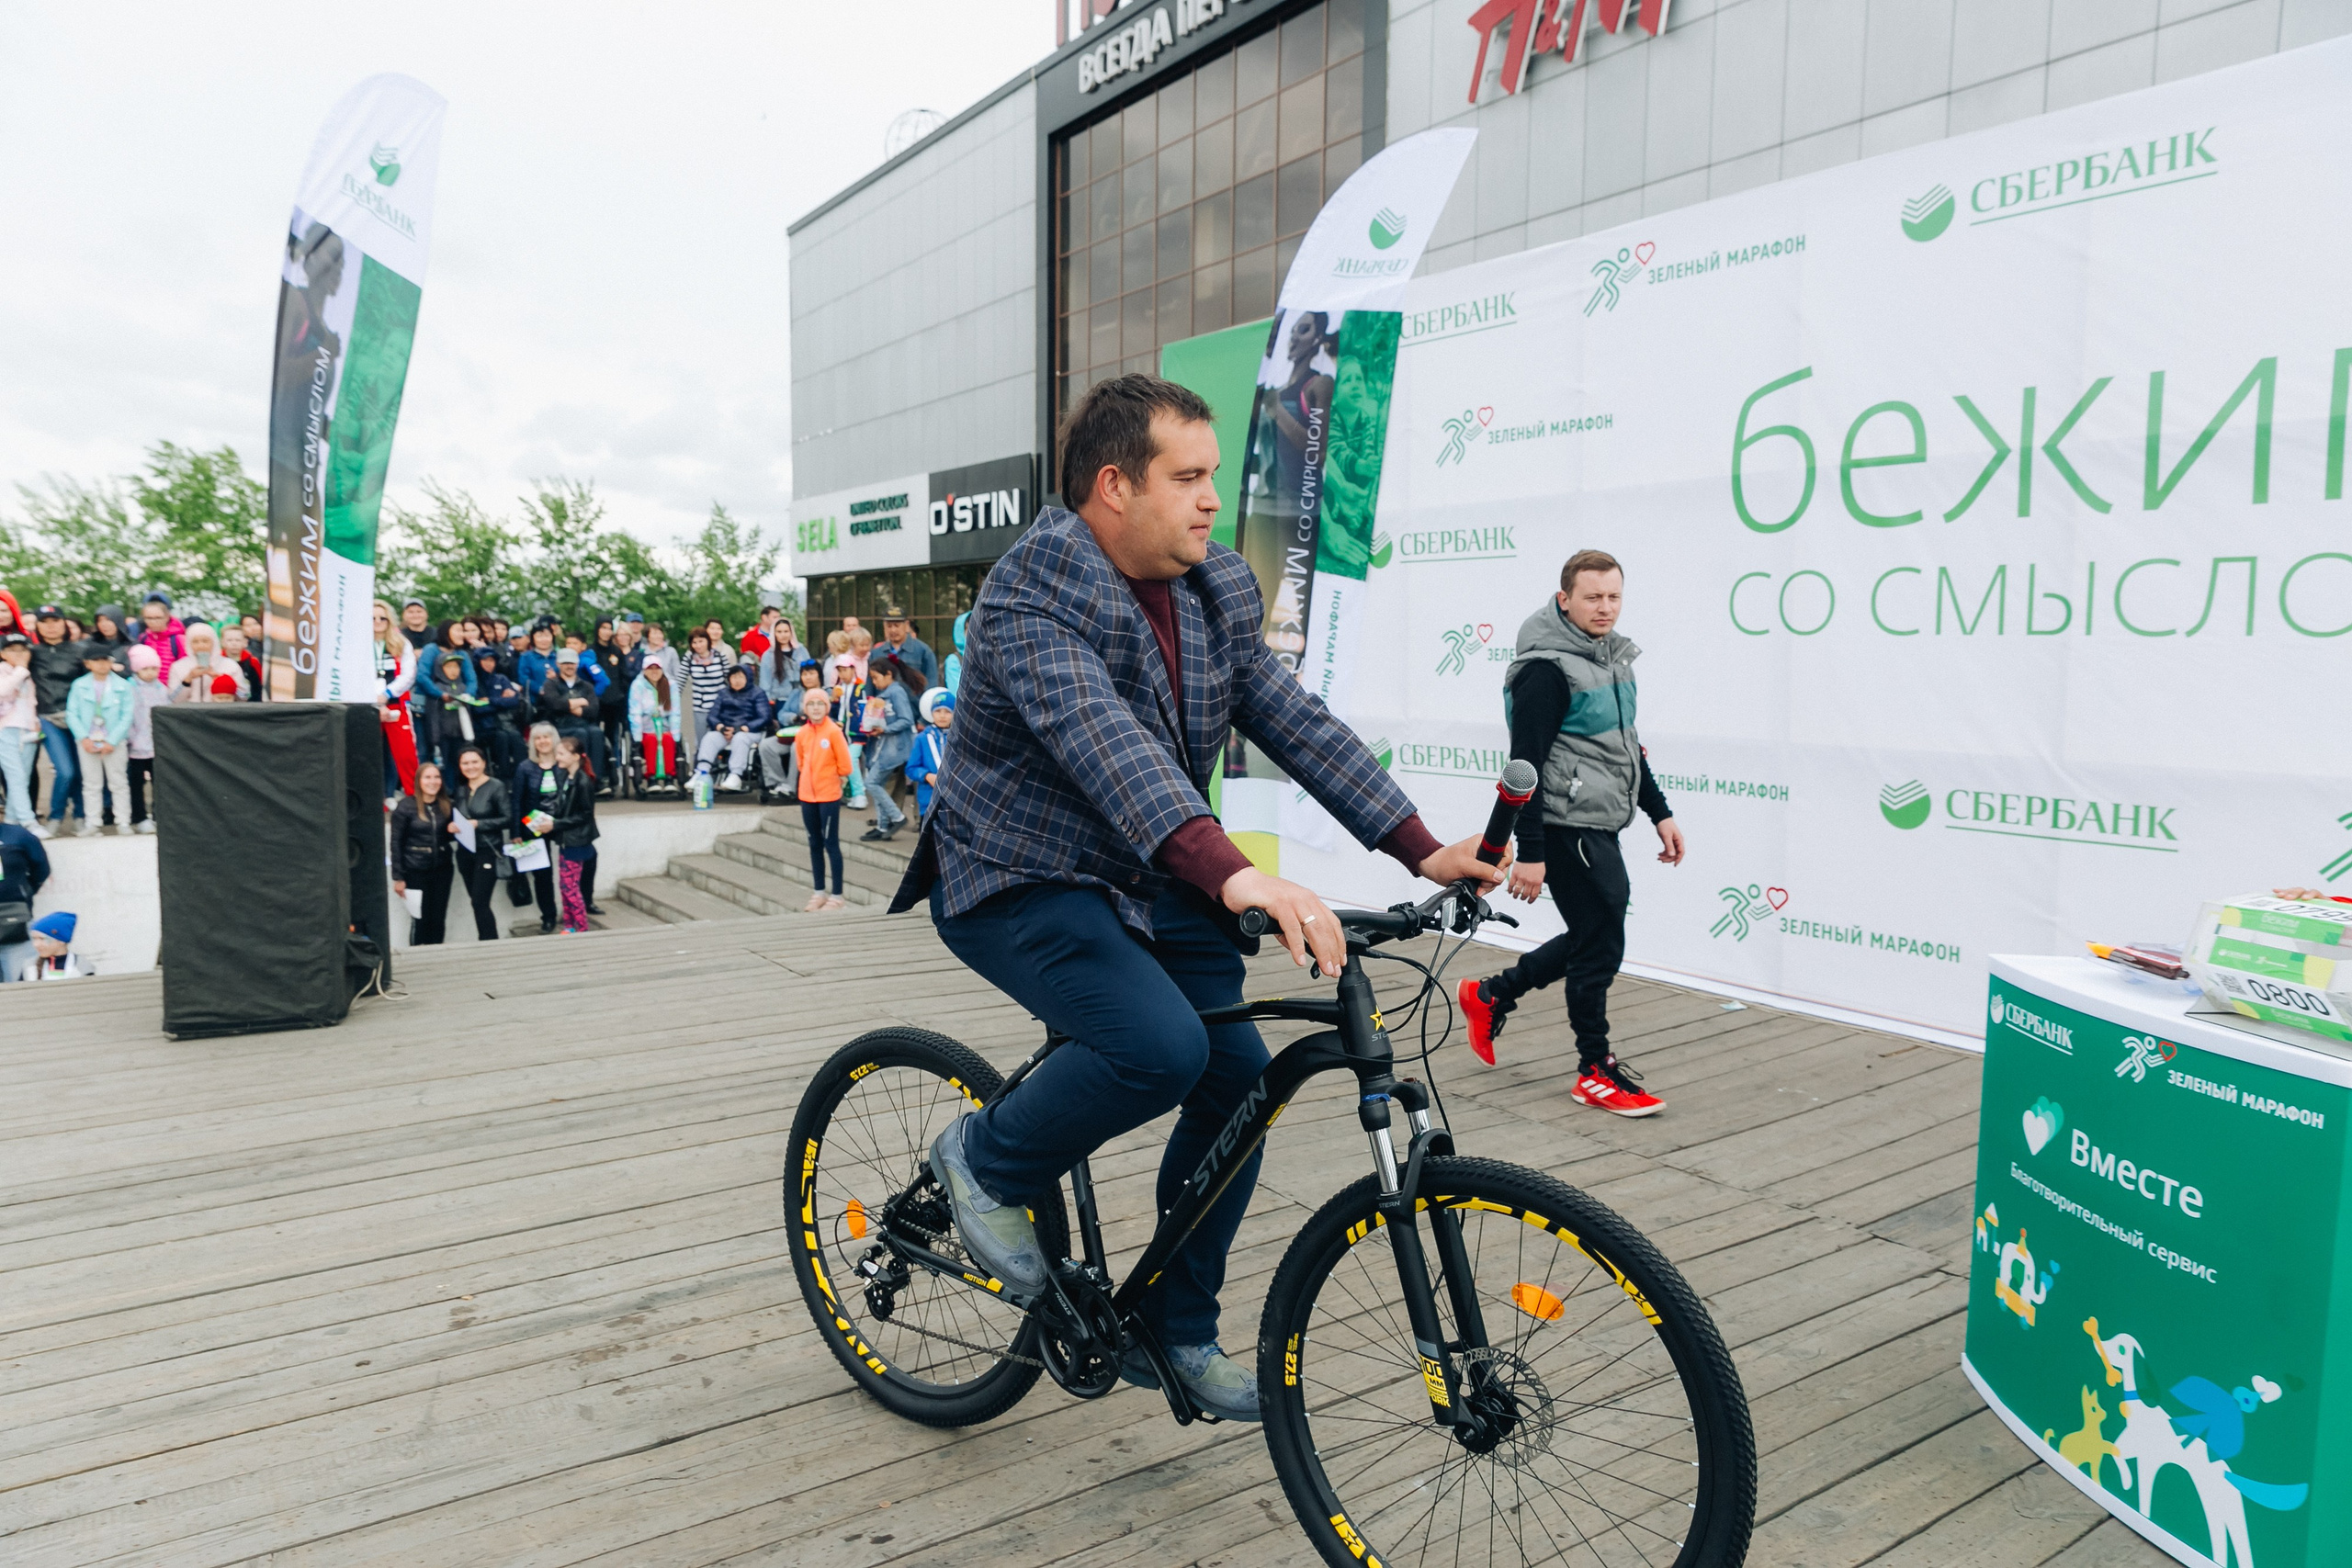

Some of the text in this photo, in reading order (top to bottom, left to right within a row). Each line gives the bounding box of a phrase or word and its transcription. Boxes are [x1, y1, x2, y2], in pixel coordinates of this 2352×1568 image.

[1079, 7, 1173, 93] ВСЕГДА
[1971, 126, 2218, 214] СБЕРБАНК
[1647, 235, 1807, 285] ЗЕЛЕНЫЙ МАРАФОН
[1400, 291, 1517, 341] СБЕРБАНК
[1487, 413, 1613, 445] ЗЕЛЕНЫЙ МАРАФОН
[797, 516, 839, 552] SELA
[1400, 526, 1516, 556] СБЕРБАНК
[288, 513, 319, 675] бежим
[1653, 773, 1790, 801] ЛЕНЫЙ МАРАФОН
[1945, 789, 2178, 841] СБЕРБАНК
[1780, 918, 1961, 964] ЗЕЛЕНЫЙ МАРАФОН
[2247, 978, 2331, 1016] 0800
[2006, 1002, 2074, 1050] СБЕРБАНК
[2167, 1069, 2324, 1130] ЗЕЛЕНЫЙ МАРАФОН
[1194, 1075, 1268, 1196] STERN
[2070, 1128, 2204, 1219] Вместе
[2011, 1161, 2218, 1284] Благотворительный сервис
[963, 1272, 988, 1287] MOTION
[1284, 1351, 1297, 1386] 27.5
